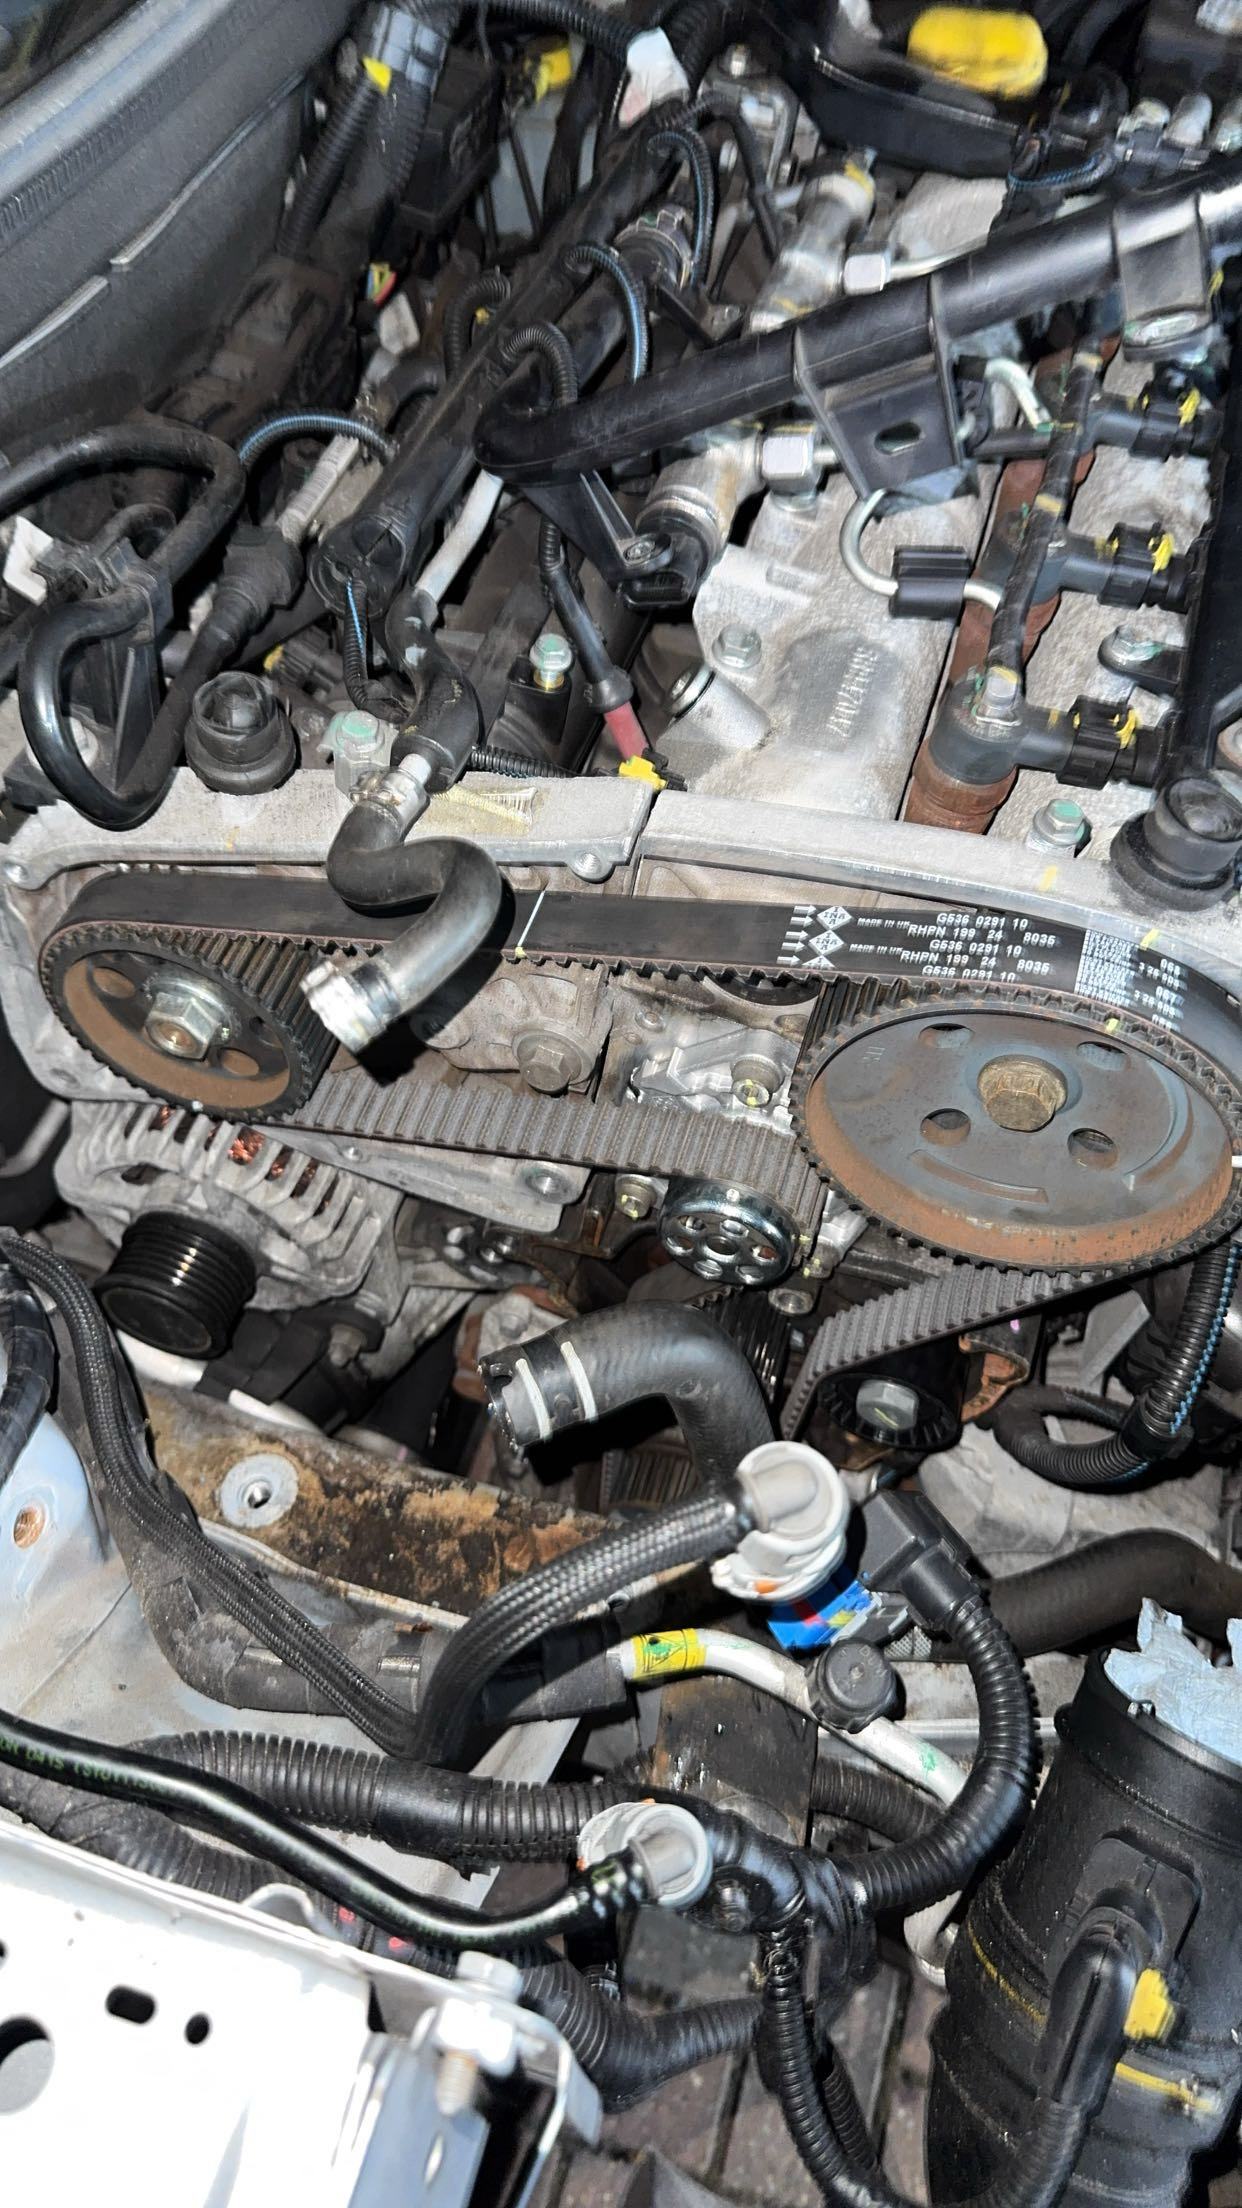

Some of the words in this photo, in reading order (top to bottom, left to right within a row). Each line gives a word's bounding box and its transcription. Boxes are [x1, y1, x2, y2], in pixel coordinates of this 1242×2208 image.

[857, 917, 882, 927] MADE
[884, 919, 895, 928] IN
[936, 912, 969, 926] G536
[975, 915, 1006, 928] 0291
[1012, 918, 1029, 930] 10
[907, 923, 946, 937] RHPN
[953, 927, 976, 940] 199
[986, 929, 1003, 941] 24
[1022, 931, 1057, 947] 8035
[849, 943, 875, 953] MADE
[876, 945, 888, 954] IN
[929, 939, 963, 953] G536
[969, 942, 1000, 955] 0291
[1006, 945, 1022, 958] 10
[900, 950, 939, 964] RHPN
[946, 953, 969, 967] 199
[980, 956, 997, 968] 24
[1016, 959, 1050, 975] 8035
